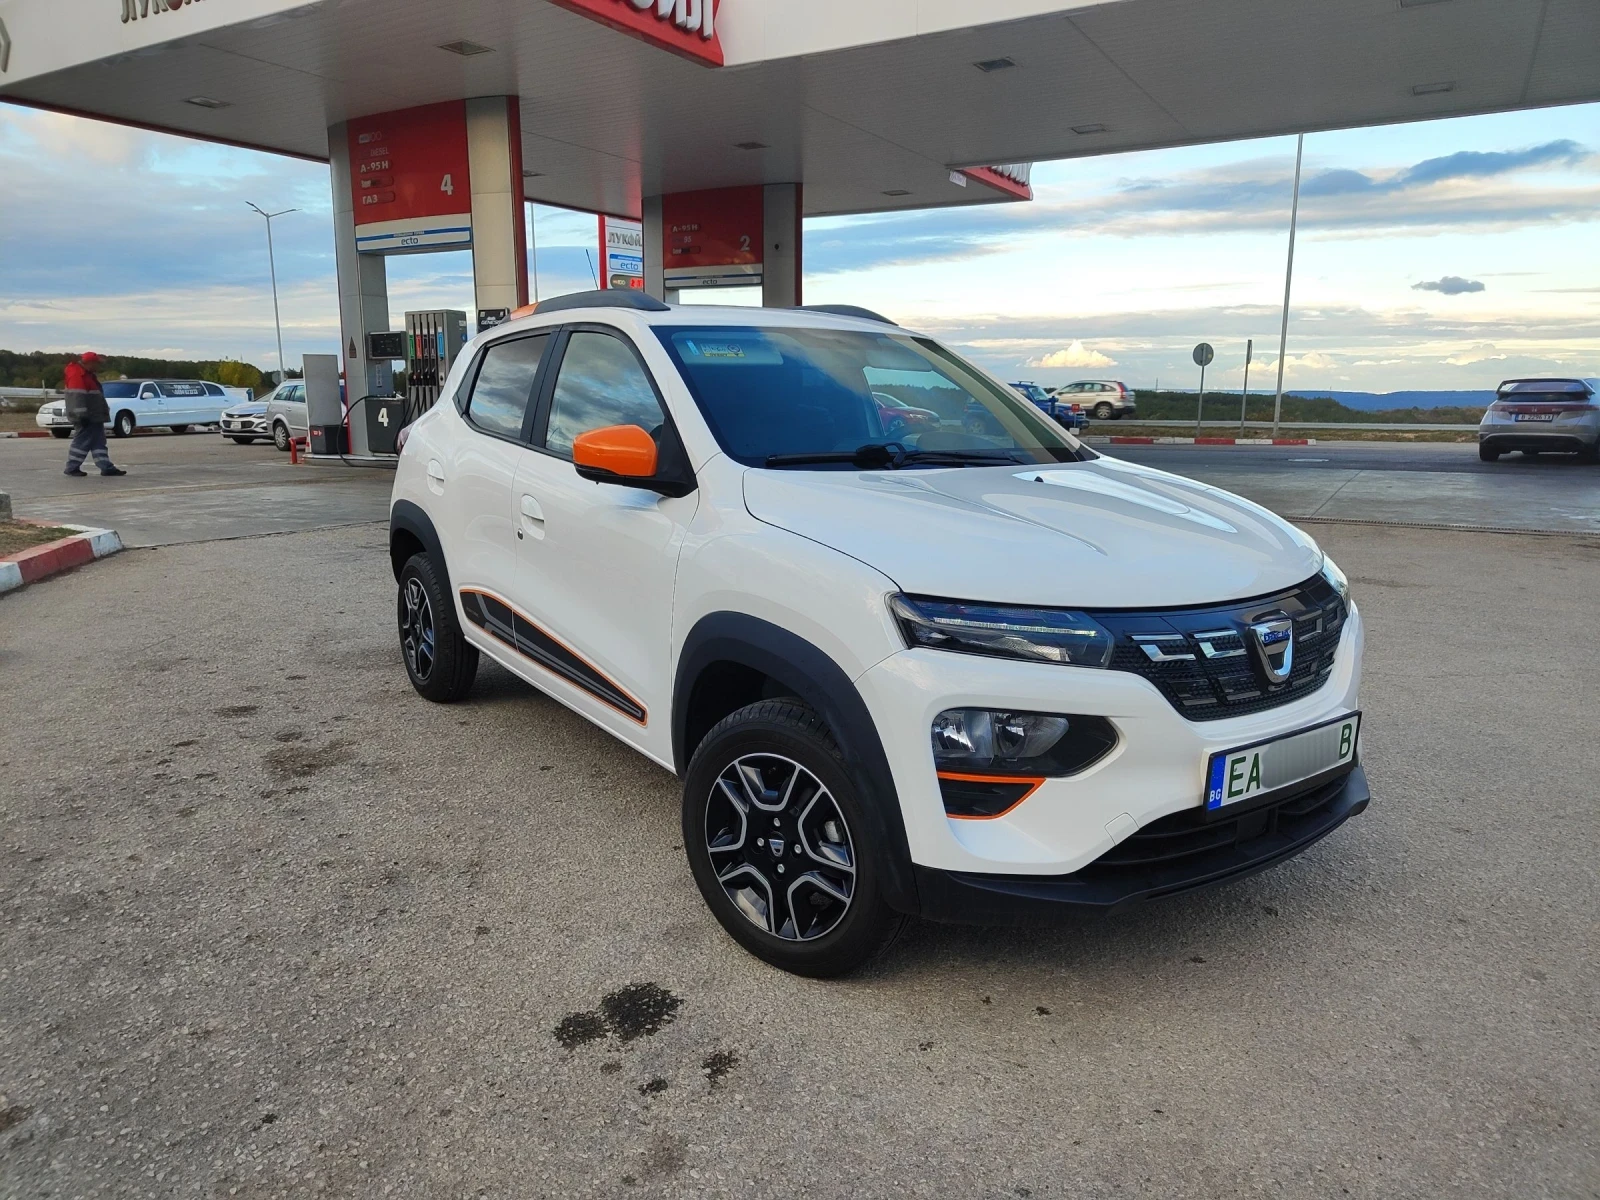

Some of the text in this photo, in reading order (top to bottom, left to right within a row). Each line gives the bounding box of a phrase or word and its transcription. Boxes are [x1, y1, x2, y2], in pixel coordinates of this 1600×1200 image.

[440, 173, 454, 196] 4
[362, 194, 378, 205] ГАЗ
[401, 237, 419, 245] ecto
[739, 235, 751, 251] 2
[620, 261, 639, 270] ecto
[377, 407, 389, 427] 4
[1227, 723, 1352, 799] EA B
[1209, 788, 1222, 802] BG
